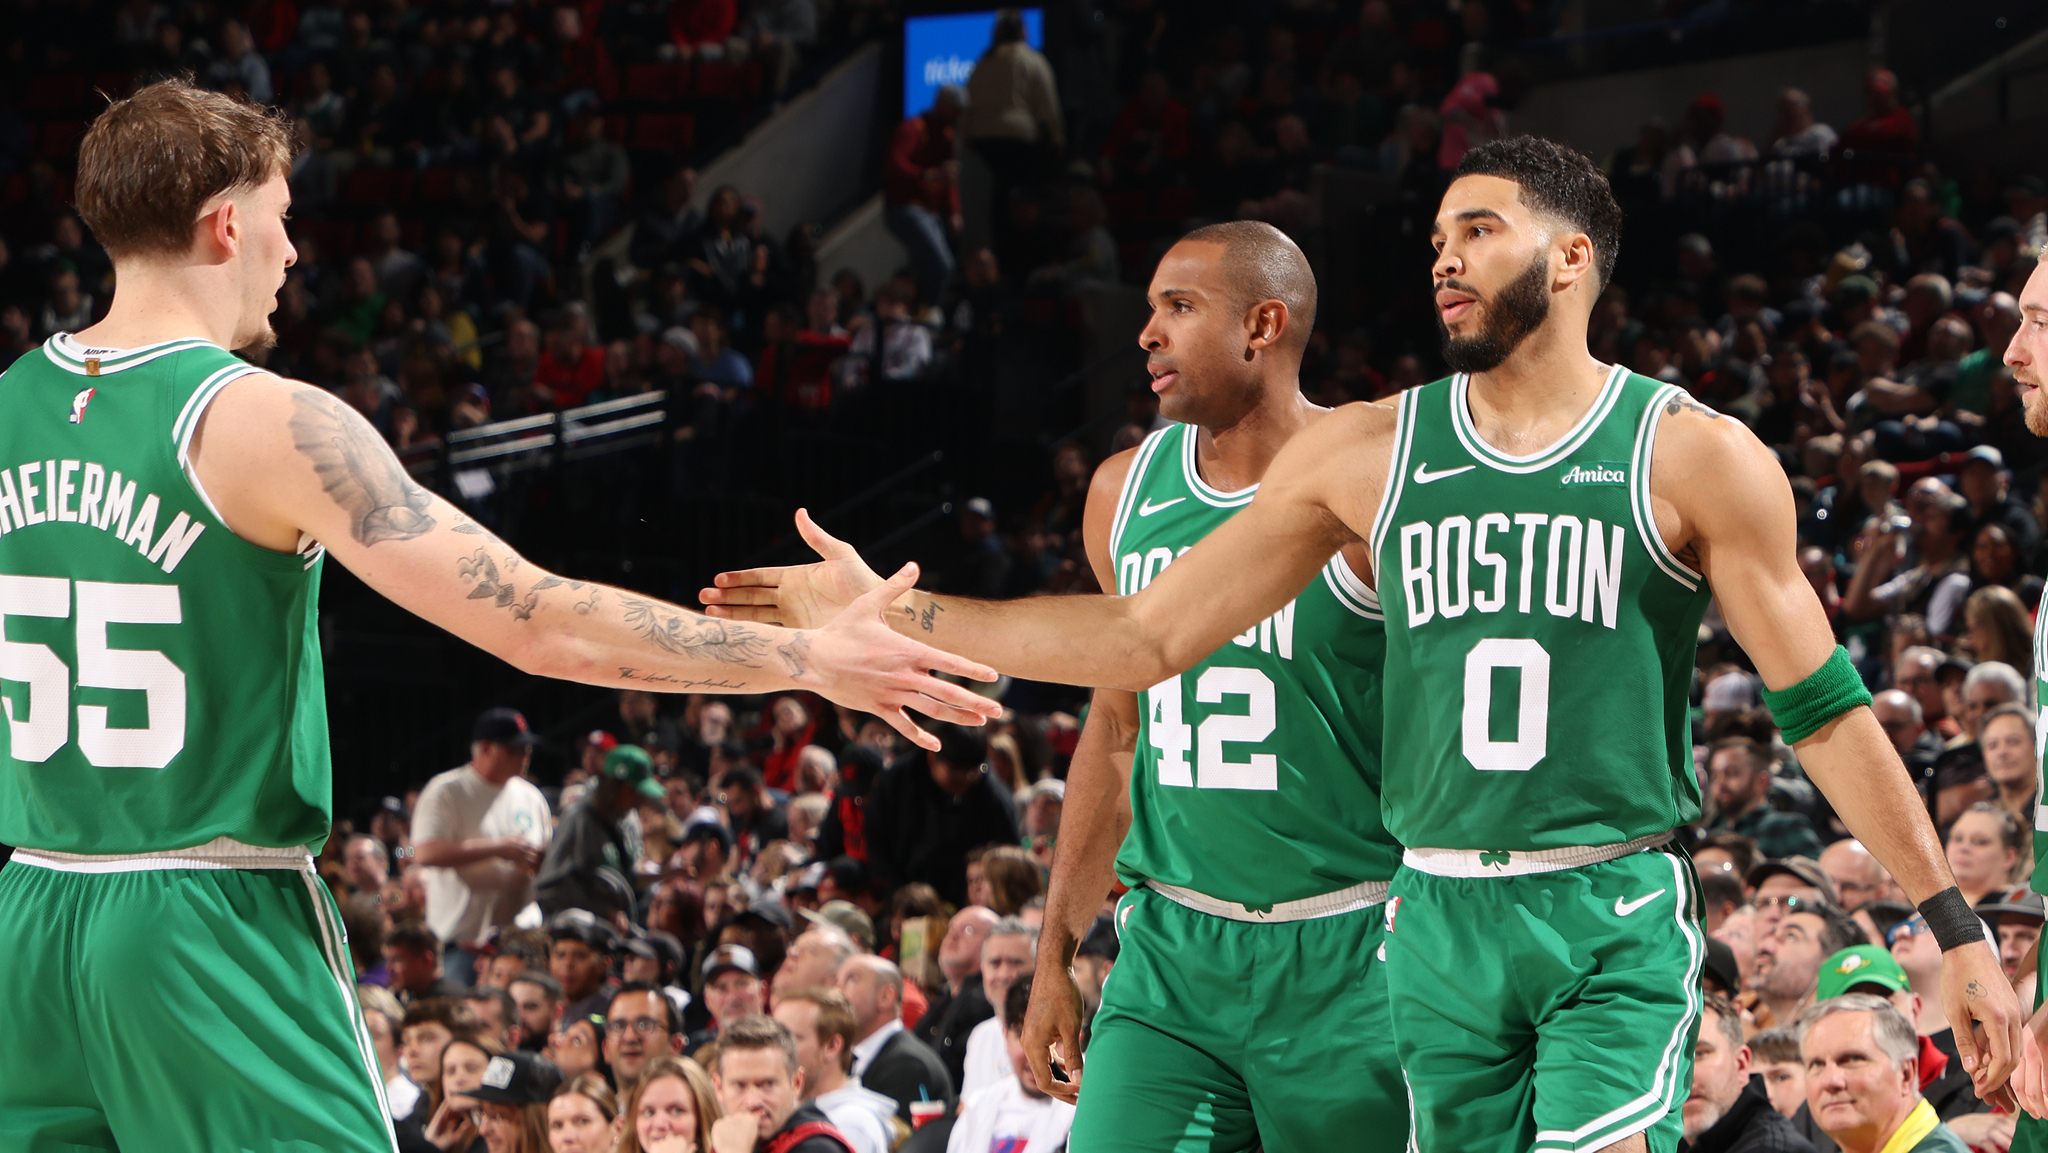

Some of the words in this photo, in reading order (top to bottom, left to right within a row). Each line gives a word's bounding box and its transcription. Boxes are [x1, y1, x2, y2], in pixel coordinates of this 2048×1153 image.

[0, 459, 206, 574] HEIERMAN
[1561, 465, 1625, 485] Amica
[1401, 512, 1625, 630] BOSTON
[0, 574, 188, 769] 55
[1148, 666, 1278, 791] 42
[1462, 637, 1551, 771] 0
